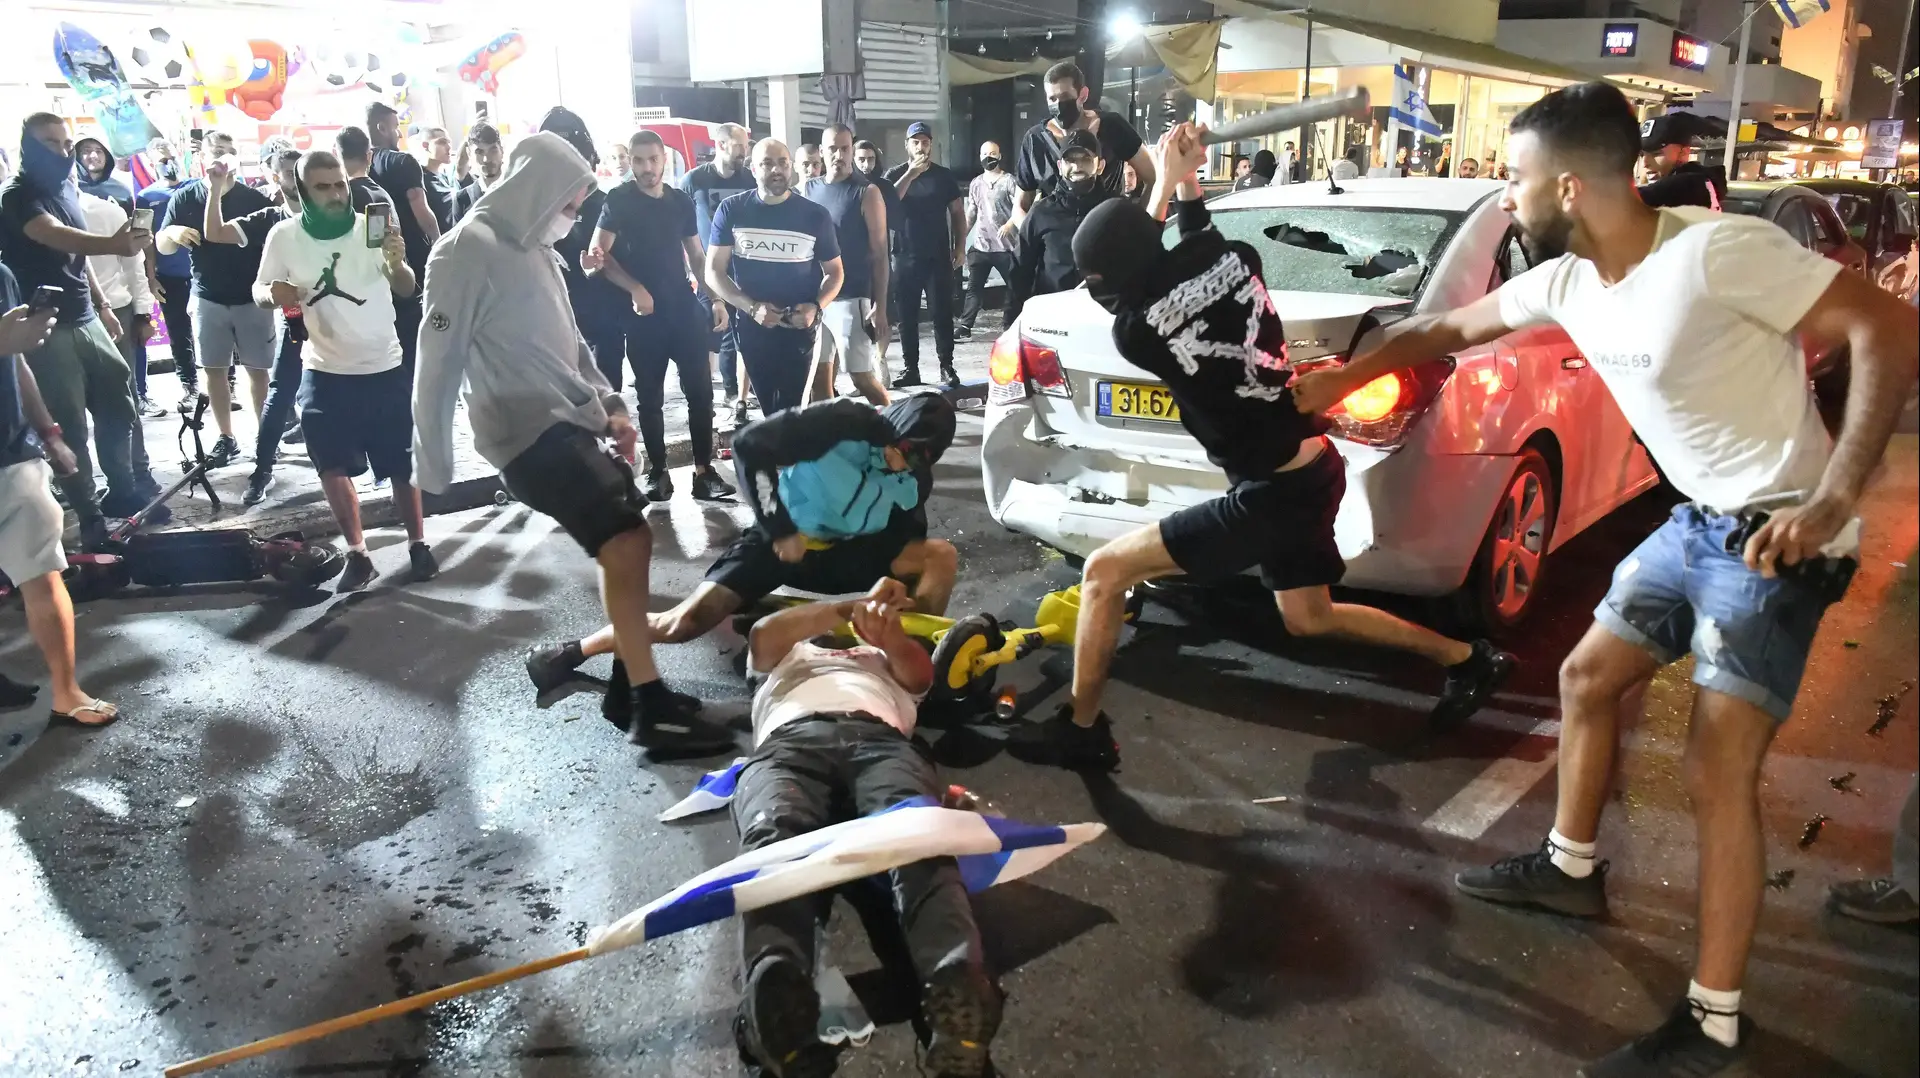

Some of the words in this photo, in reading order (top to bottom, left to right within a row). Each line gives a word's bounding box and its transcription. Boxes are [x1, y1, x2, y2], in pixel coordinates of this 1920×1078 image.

[740, 239, 799, 253] GANT
[1631, 353, 1652, 368] 69
[1101, 392, 1110, 406] IL
